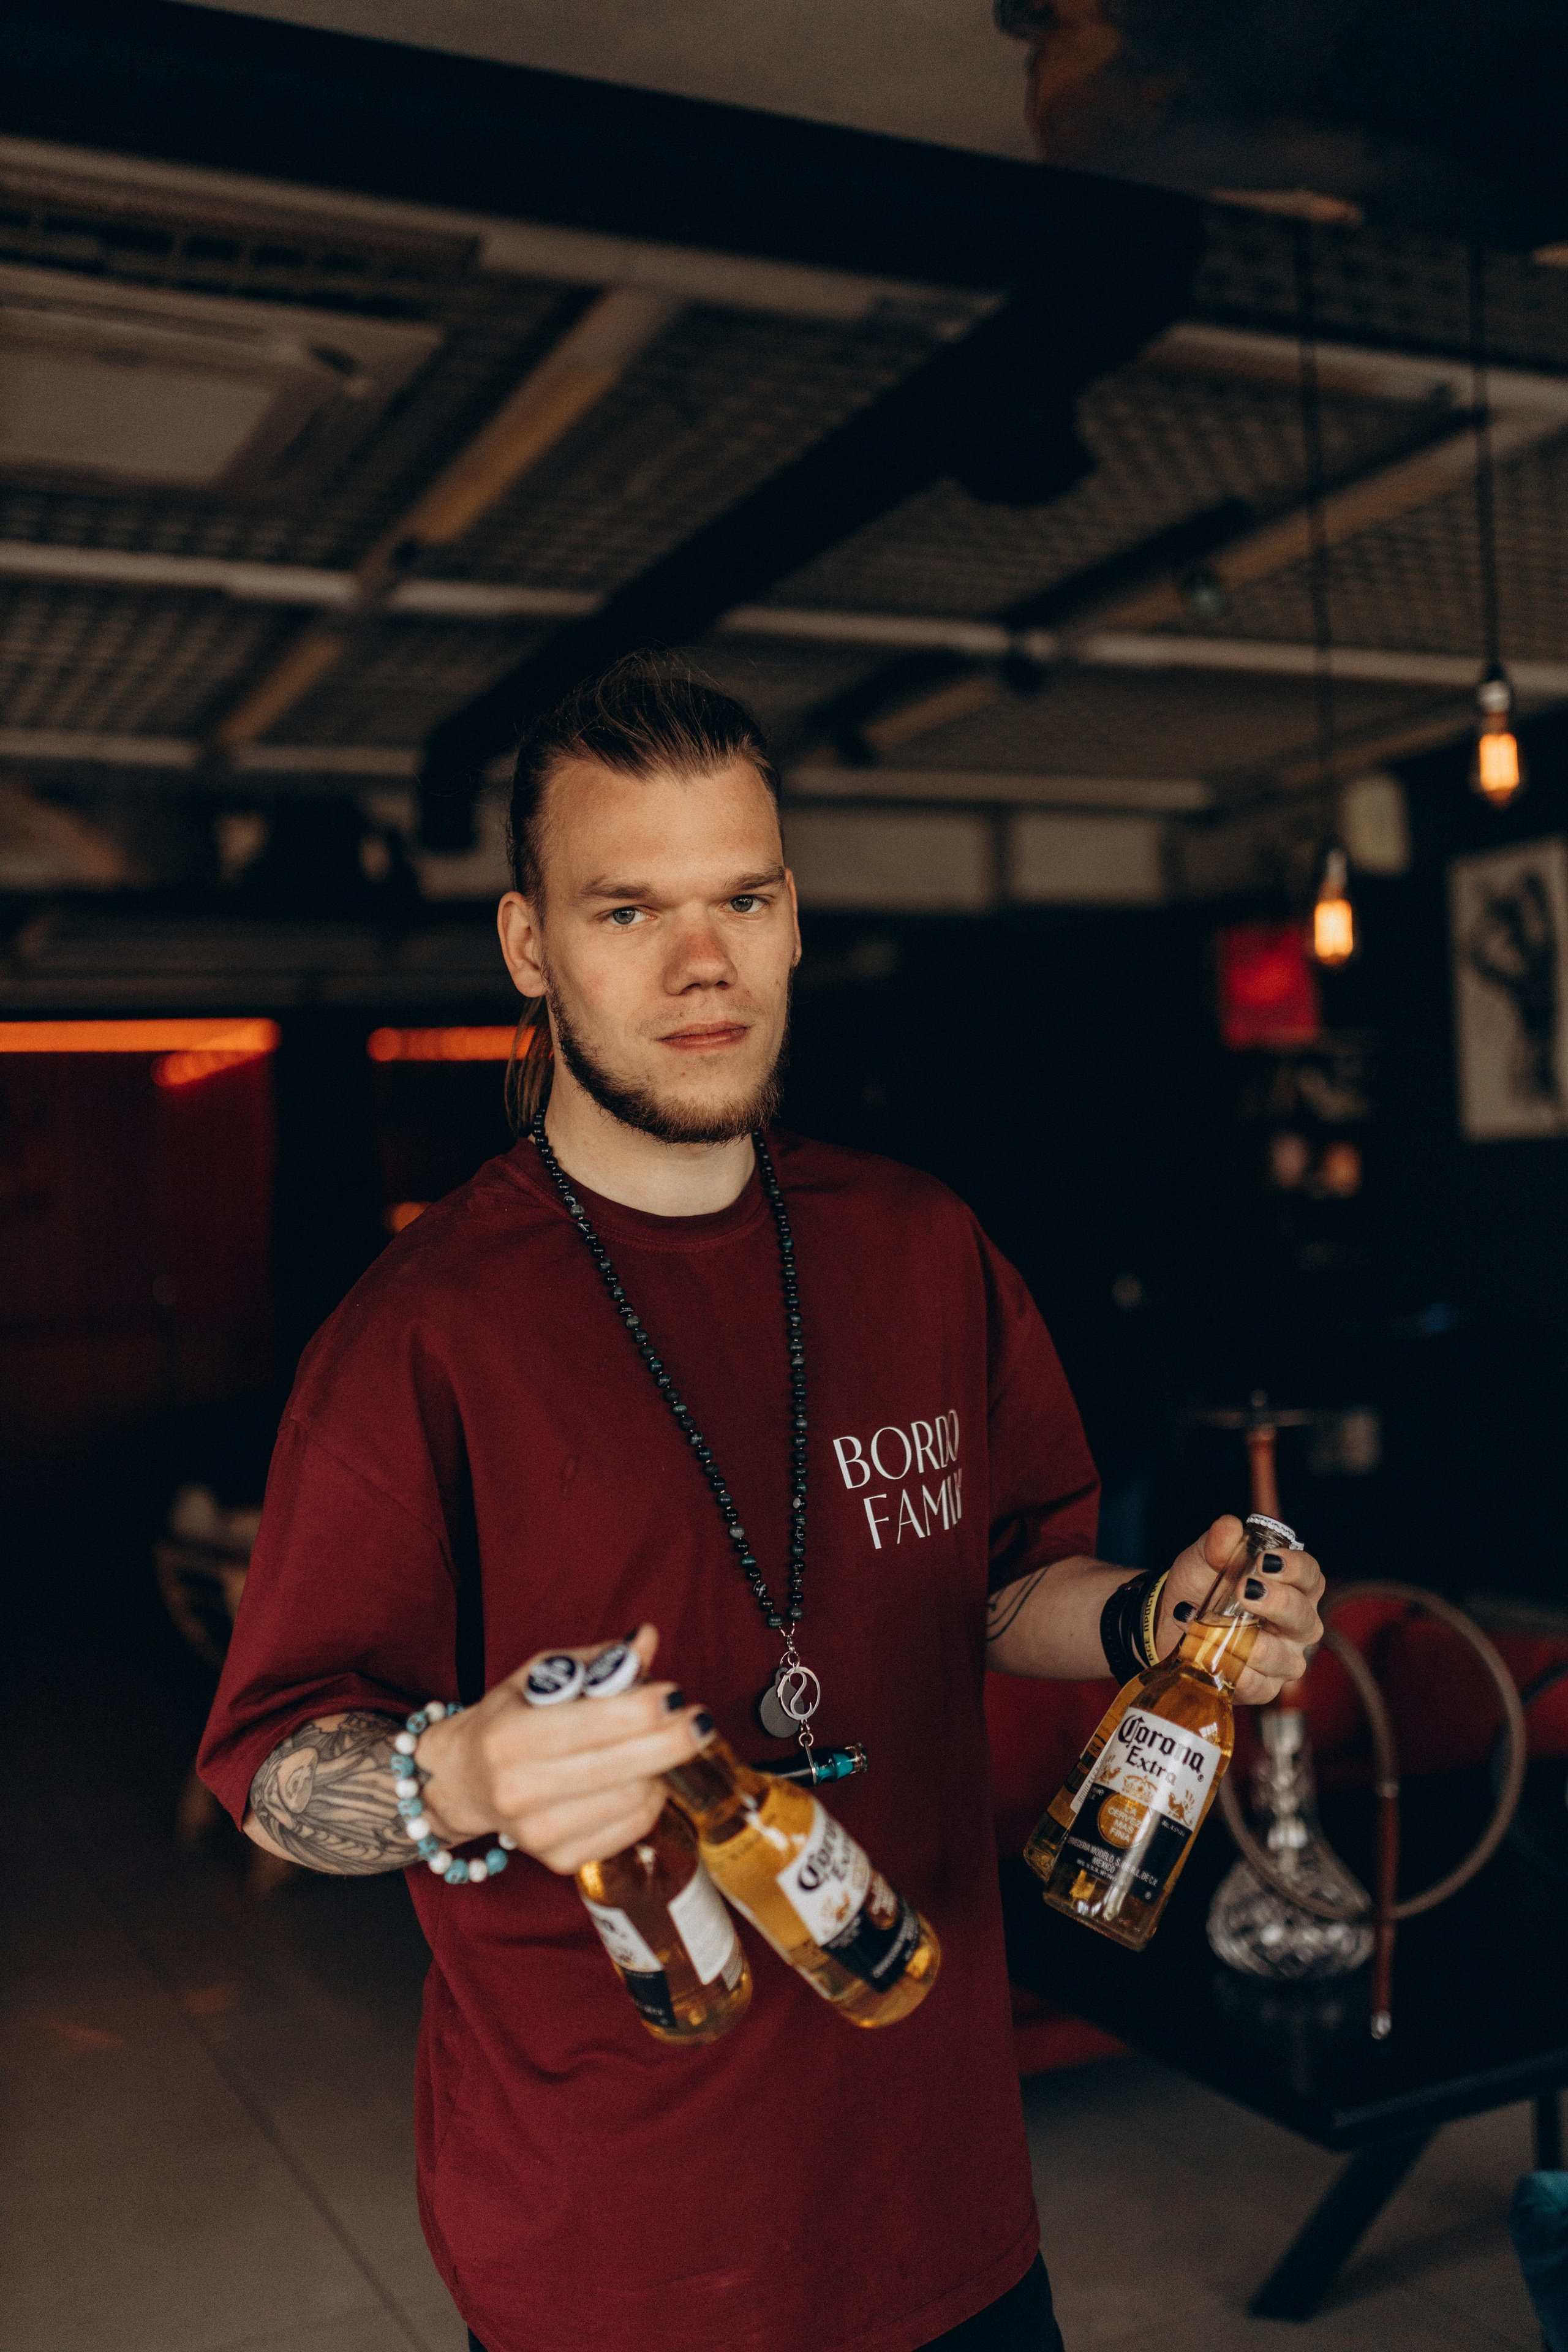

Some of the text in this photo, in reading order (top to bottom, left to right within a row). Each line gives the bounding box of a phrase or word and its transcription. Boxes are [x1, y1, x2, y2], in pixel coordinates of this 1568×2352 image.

[832, 1409, 960, 1490] BORDO
[1118, 1714, 1205, 1774] Corona
[1125, 1745, 1177, 1786] Extra
[1108, 1806, 1143, 1828] CERVEZ
[1124, 1804, 1137, 1817] LA
[1109, 1826, 1130, 1843] FINA
[1114, 1819, 1134, 1834] MAS
